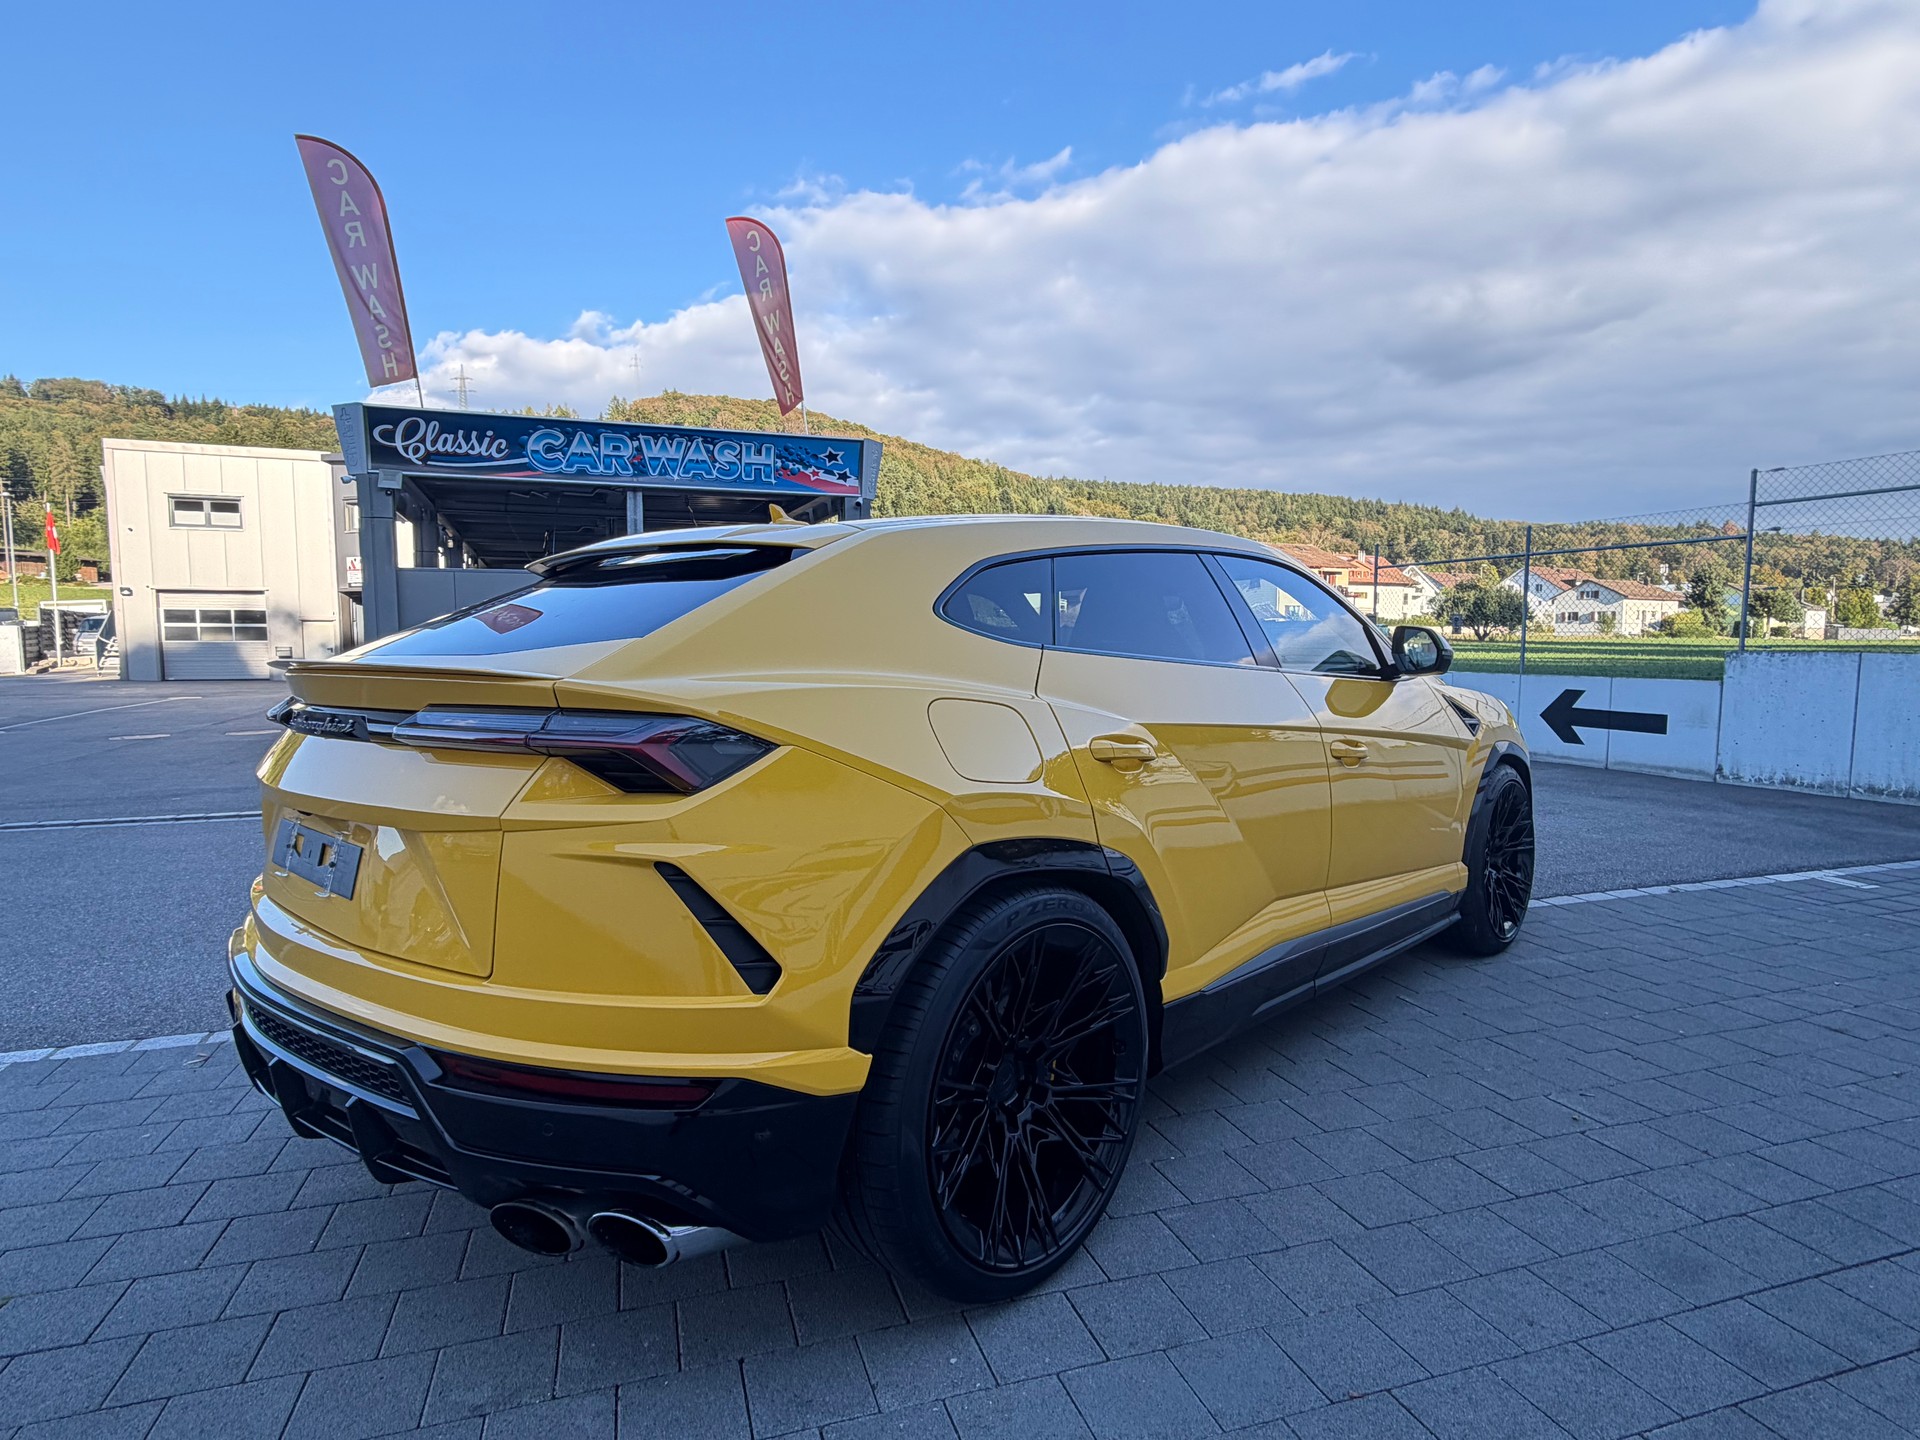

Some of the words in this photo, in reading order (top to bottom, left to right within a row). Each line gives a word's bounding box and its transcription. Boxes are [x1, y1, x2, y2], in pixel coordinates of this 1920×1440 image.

[373, 417, 508, 464] Classic
[526, 428, 634, 476] CAR
[639, 434, 777, 483] WASH
